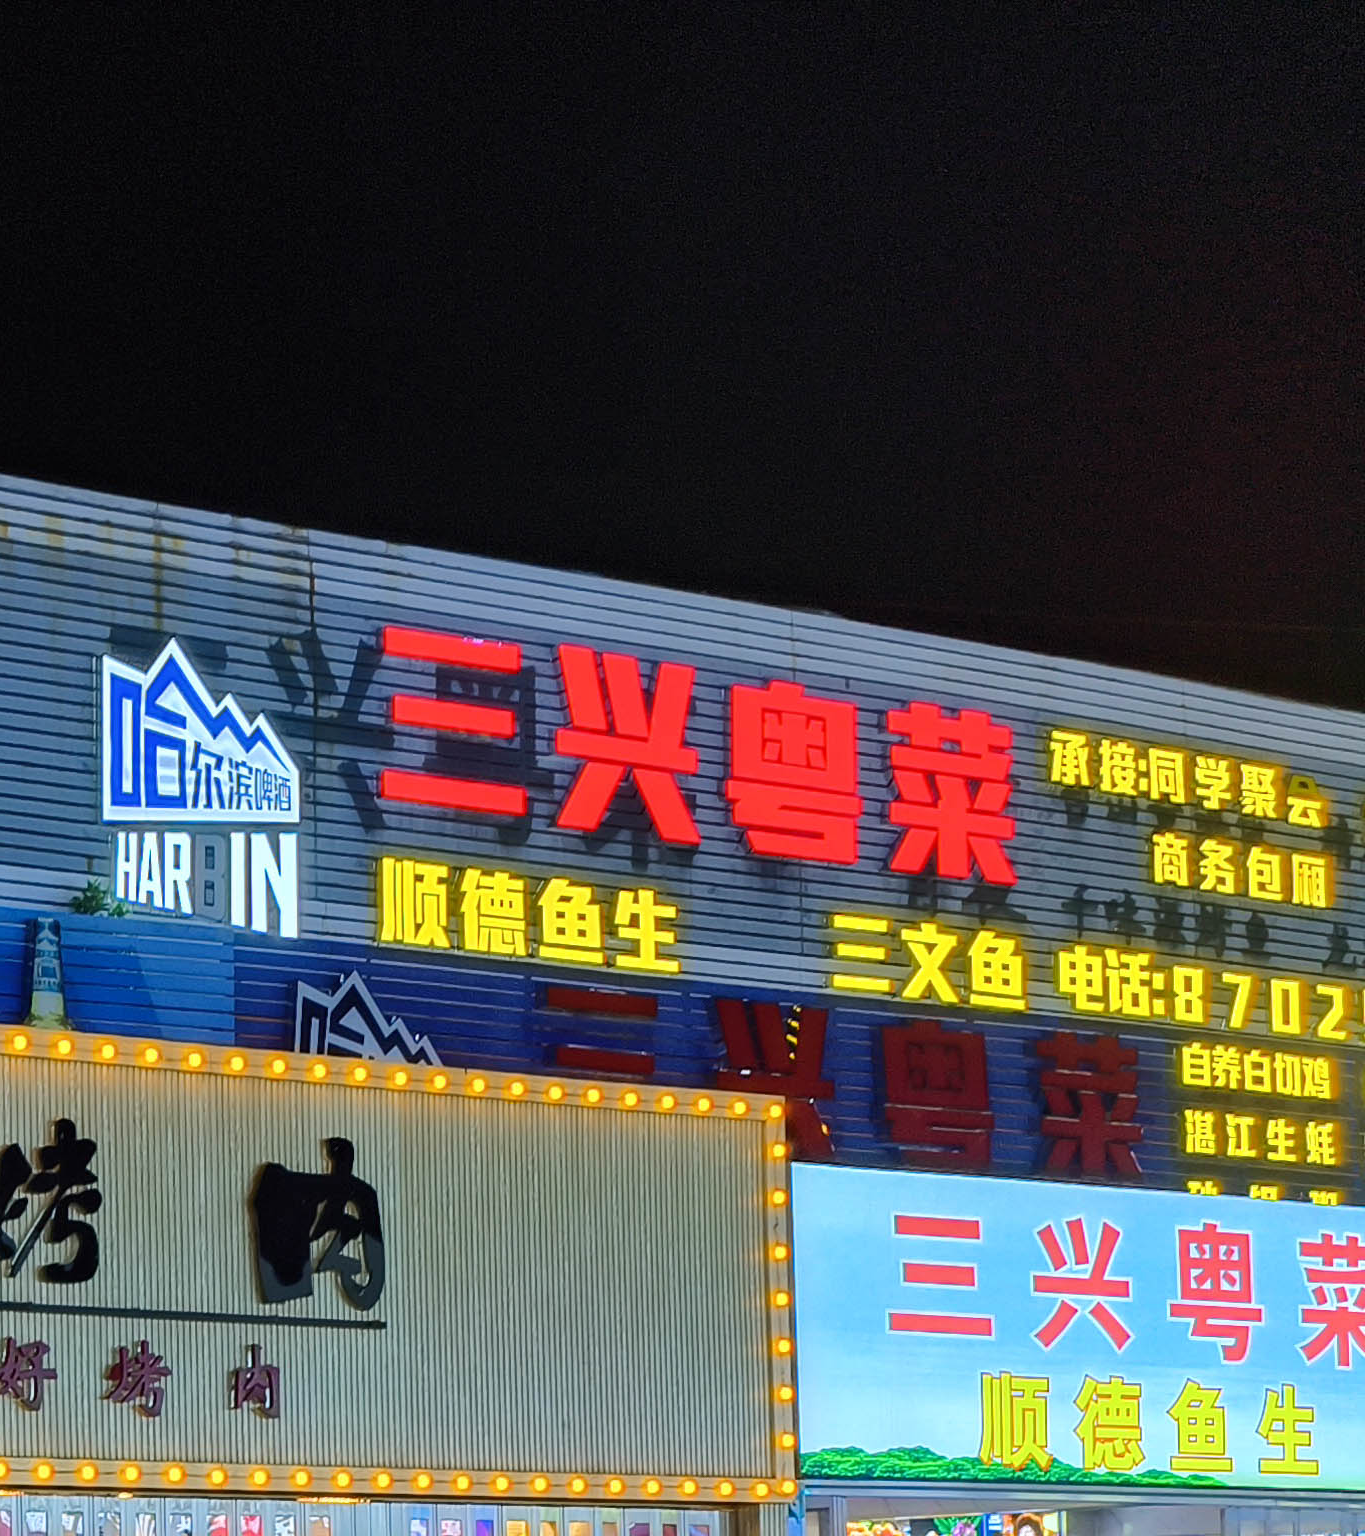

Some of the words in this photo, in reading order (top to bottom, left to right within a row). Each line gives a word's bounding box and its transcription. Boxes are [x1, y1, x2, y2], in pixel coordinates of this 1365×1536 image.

[109, 652, 293, 813] 哈尔滨啤酒
[380, 624, 1020, 887] 三兴粤菜
[113, 831, 300, 939] HARBIN
[1151, 831, 1335, 909] 商务包厢
[379, 856, 681, 975] 顺德鱼生
[830, 912, 1029, 1013] 三文鱼
[1057, 944, 1365, 1041] 电话:8702
[1181, 1041, 1337, 1100] 自养白切鸡
[1183, 1108, 1340, 1167] 湛江生蚝
[887, 1213, 1365, 1370] 三兴粤菜
[977, 1371, 1321, 1476] 顺德鱼生
